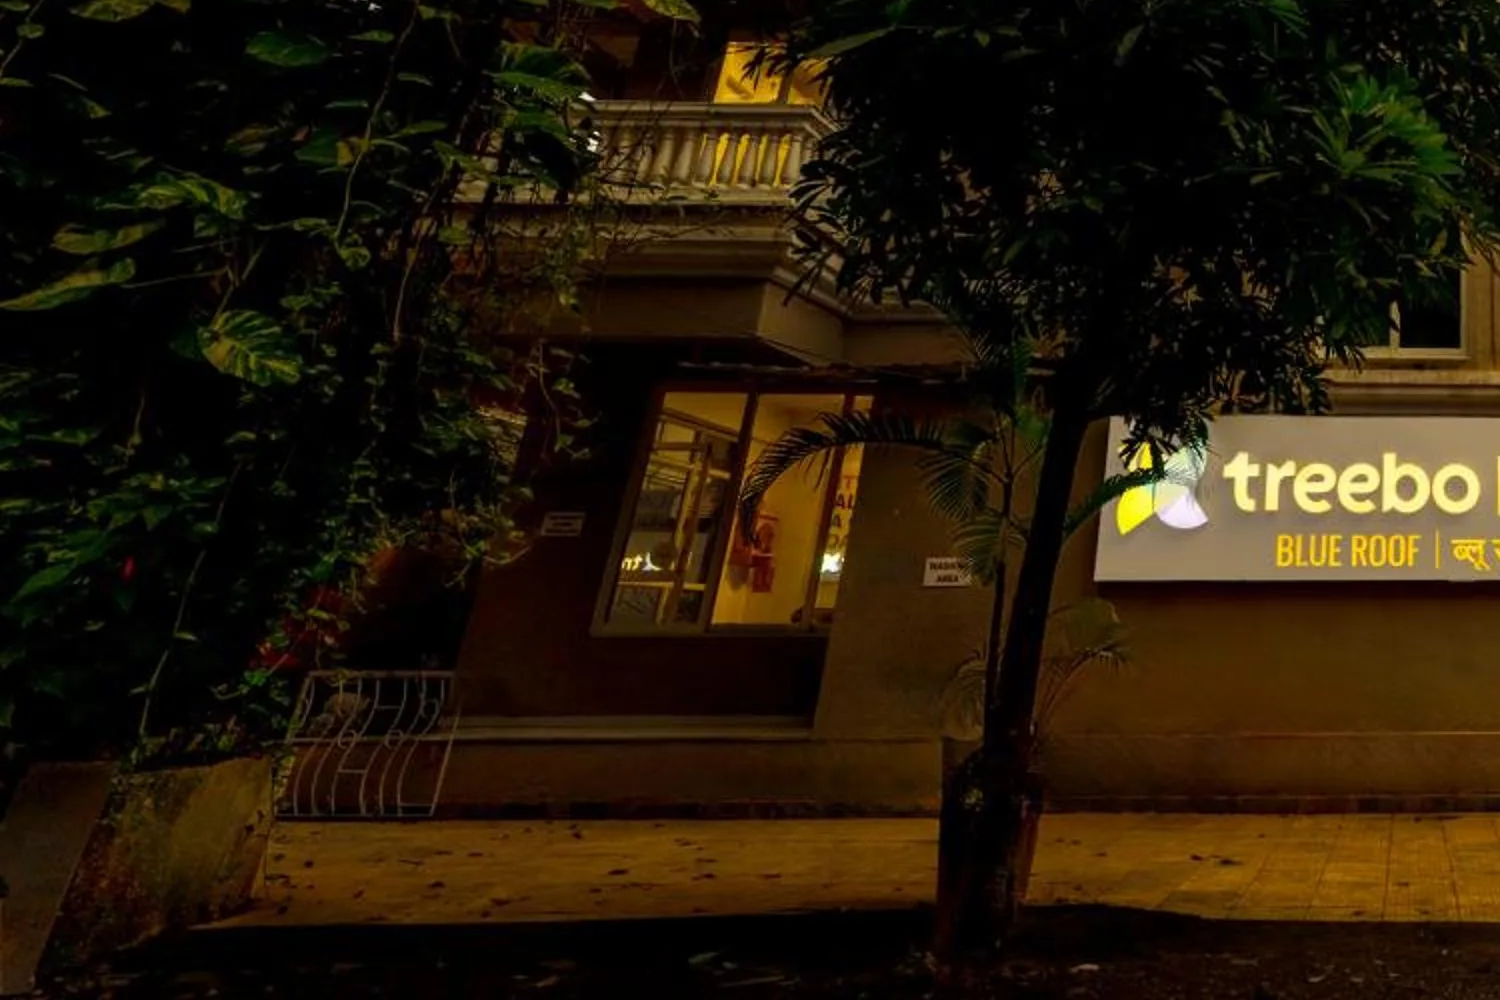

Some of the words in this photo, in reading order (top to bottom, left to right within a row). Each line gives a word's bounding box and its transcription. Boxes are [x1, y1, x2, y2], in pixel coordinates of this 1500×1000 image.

[1223, 452, 1481, 514] treebo
[1275, 534, 1342, 568] BLUE
[1351, 534, 1422, 568] ROOF
